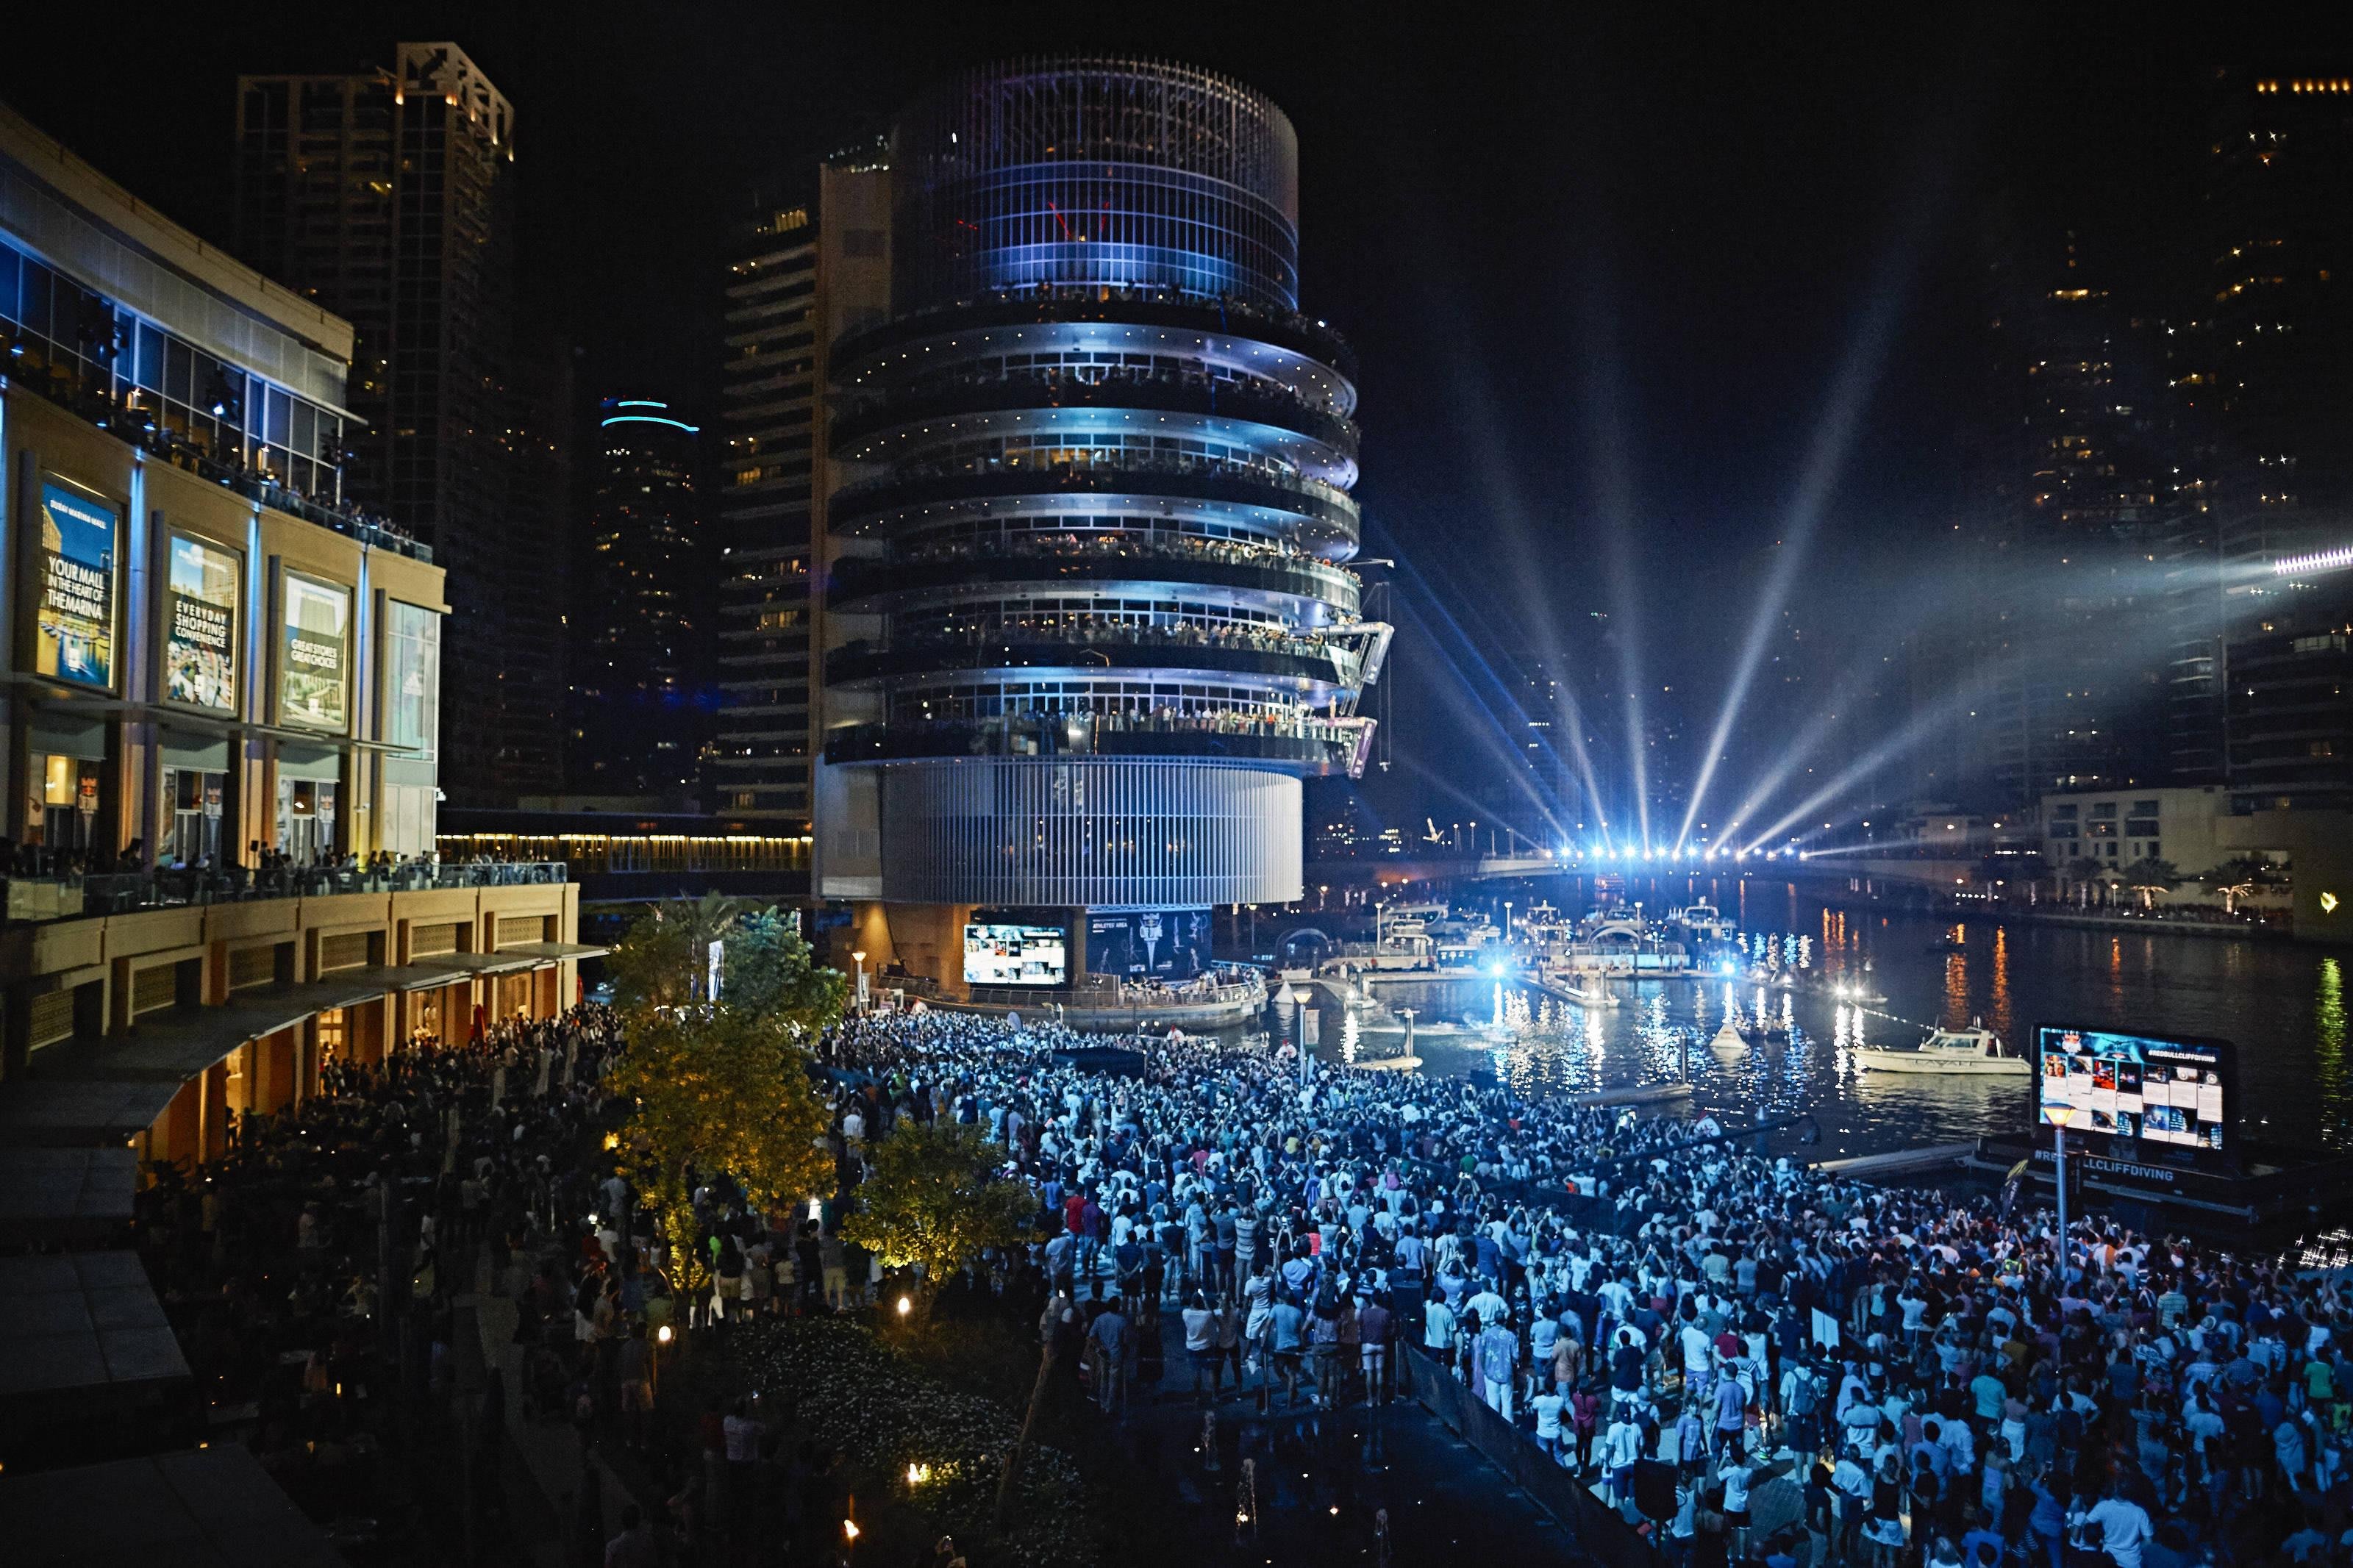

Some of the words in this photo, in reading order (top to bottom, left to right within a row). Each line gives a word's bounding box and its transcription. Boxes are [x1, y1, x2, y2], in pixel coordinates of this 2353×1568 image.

[48, 556, 79, 581] YOUR
[79, 566, 105, 590] MALL
[48, 573, 58, 588] IN
[57, 576, 72, 593] THE
[72, 581, 93, 600] HEART
[93, 589, 104, 602] OF
[47, 588, 66, 609] THE
[65, 595, 103, 620] MARINA
[176, 600, 226, 625] EVERYDAY
[175, 626, 226, 648] CONVENIENCE
[176, 613, 226, 639] SHOPPING
[2148, 1049, 2217, 1063] #REDBULLCLIFFDIVING
